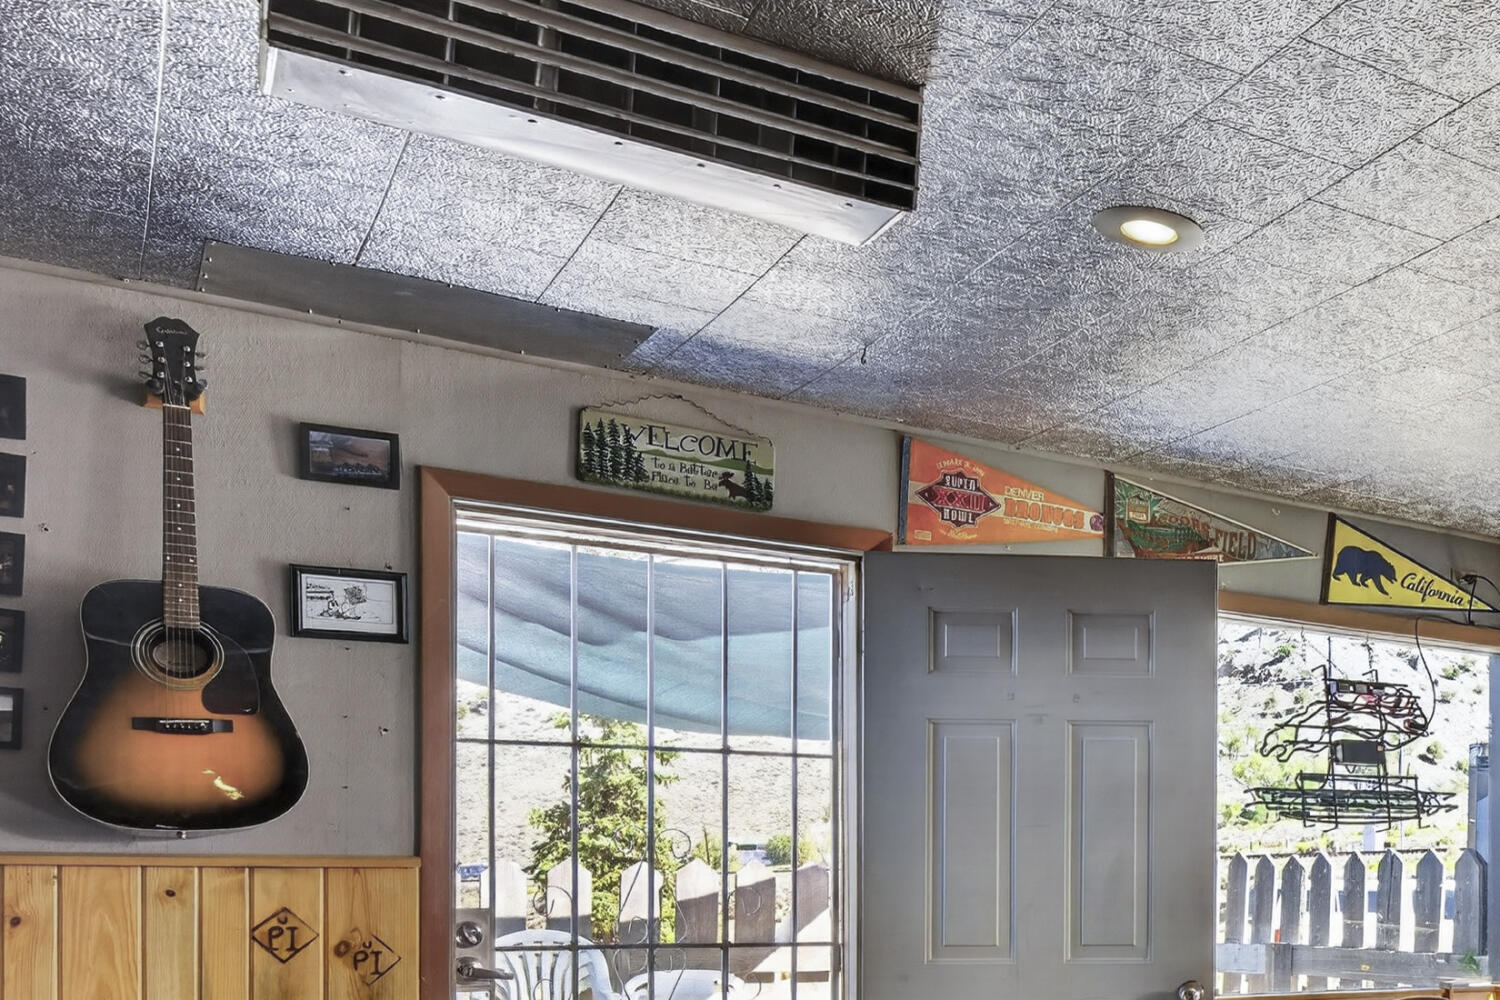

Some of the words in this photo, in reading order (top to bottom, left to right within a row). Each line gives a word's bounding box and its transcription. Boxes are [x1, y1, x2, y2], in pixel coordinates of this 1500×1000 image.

[621, 423, 758, 466] WELCOME
[1004, 486, 1045, 501] DENVER
[1214, 528, 1257, 561] FIELD
[1401, 572, 1464, 607] California
